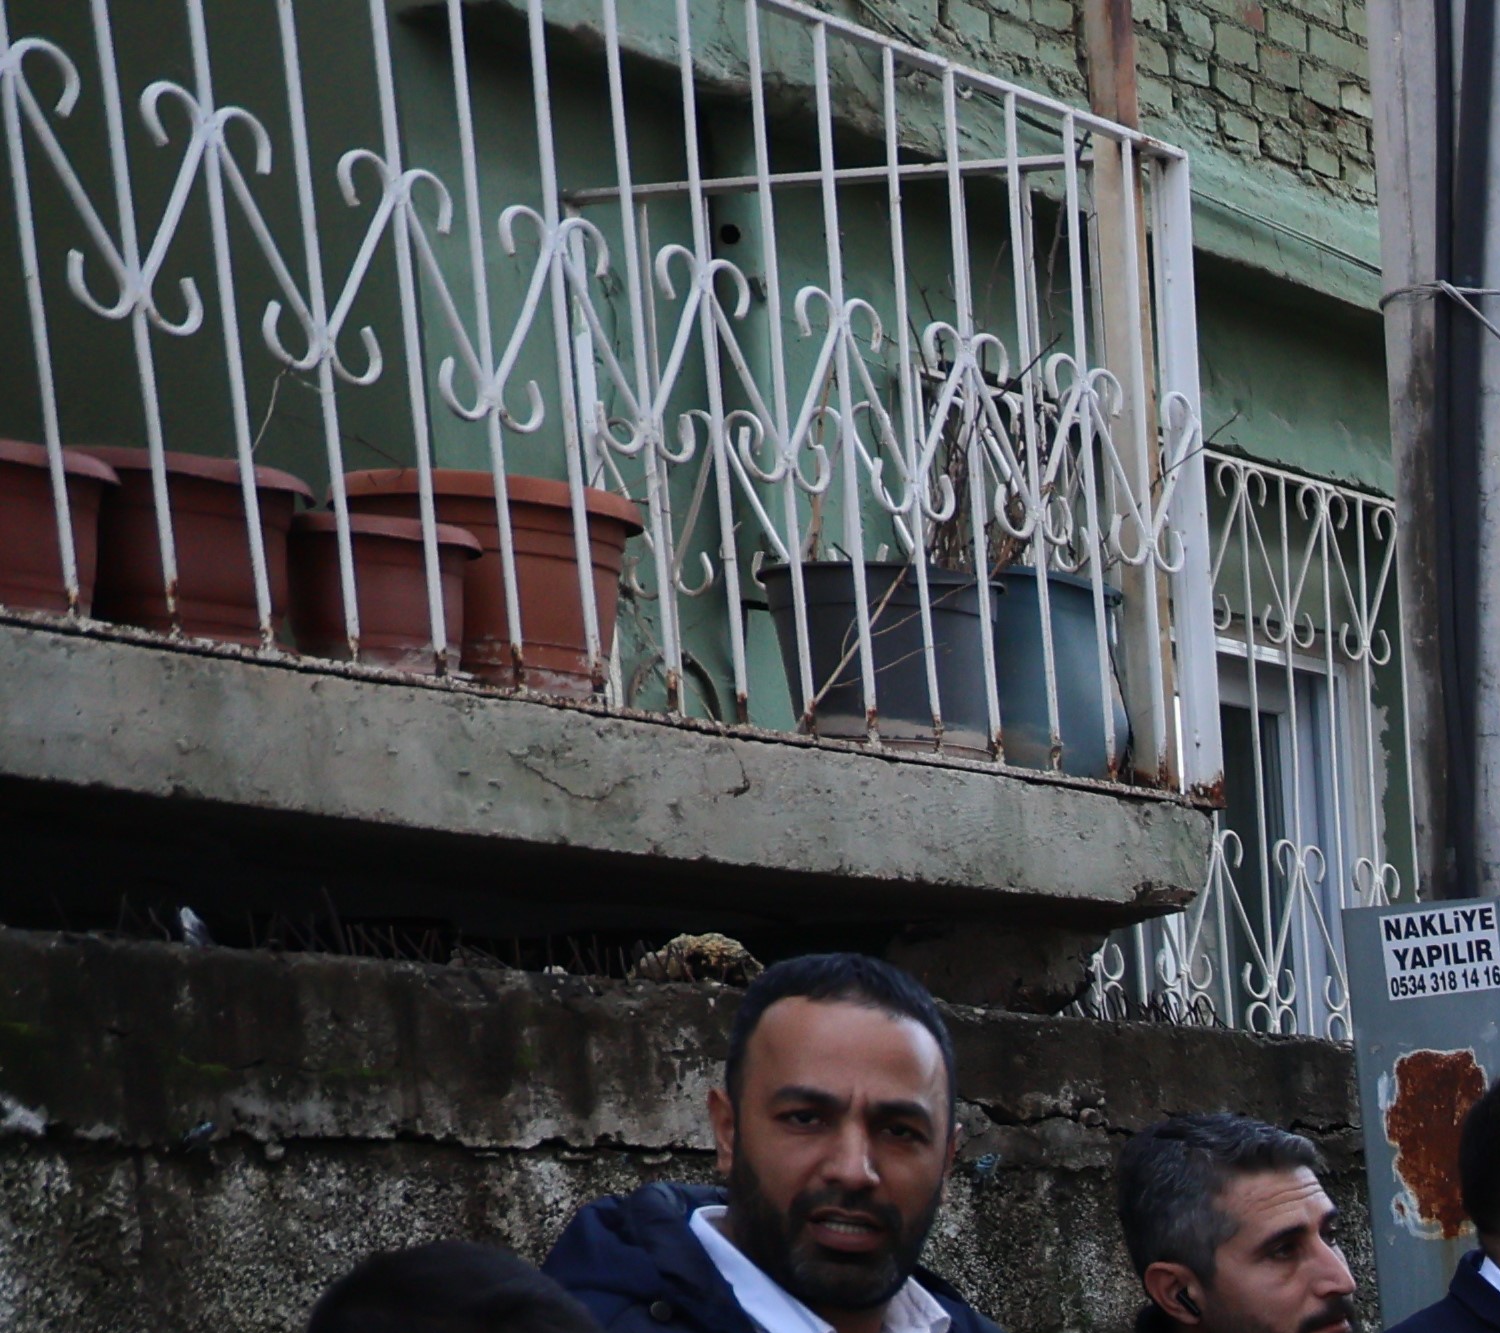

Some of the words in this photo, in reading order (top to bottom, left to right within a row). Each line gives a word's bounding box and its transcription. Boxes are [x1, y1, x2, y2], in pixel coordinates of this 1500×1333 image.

[1392, 939, 1493, 971] YAPILIR
[1390, 974, 1426, 997] 0534
[1430, 970, 1457, 992] 318
[1462, 968, 1479, 988] 14
